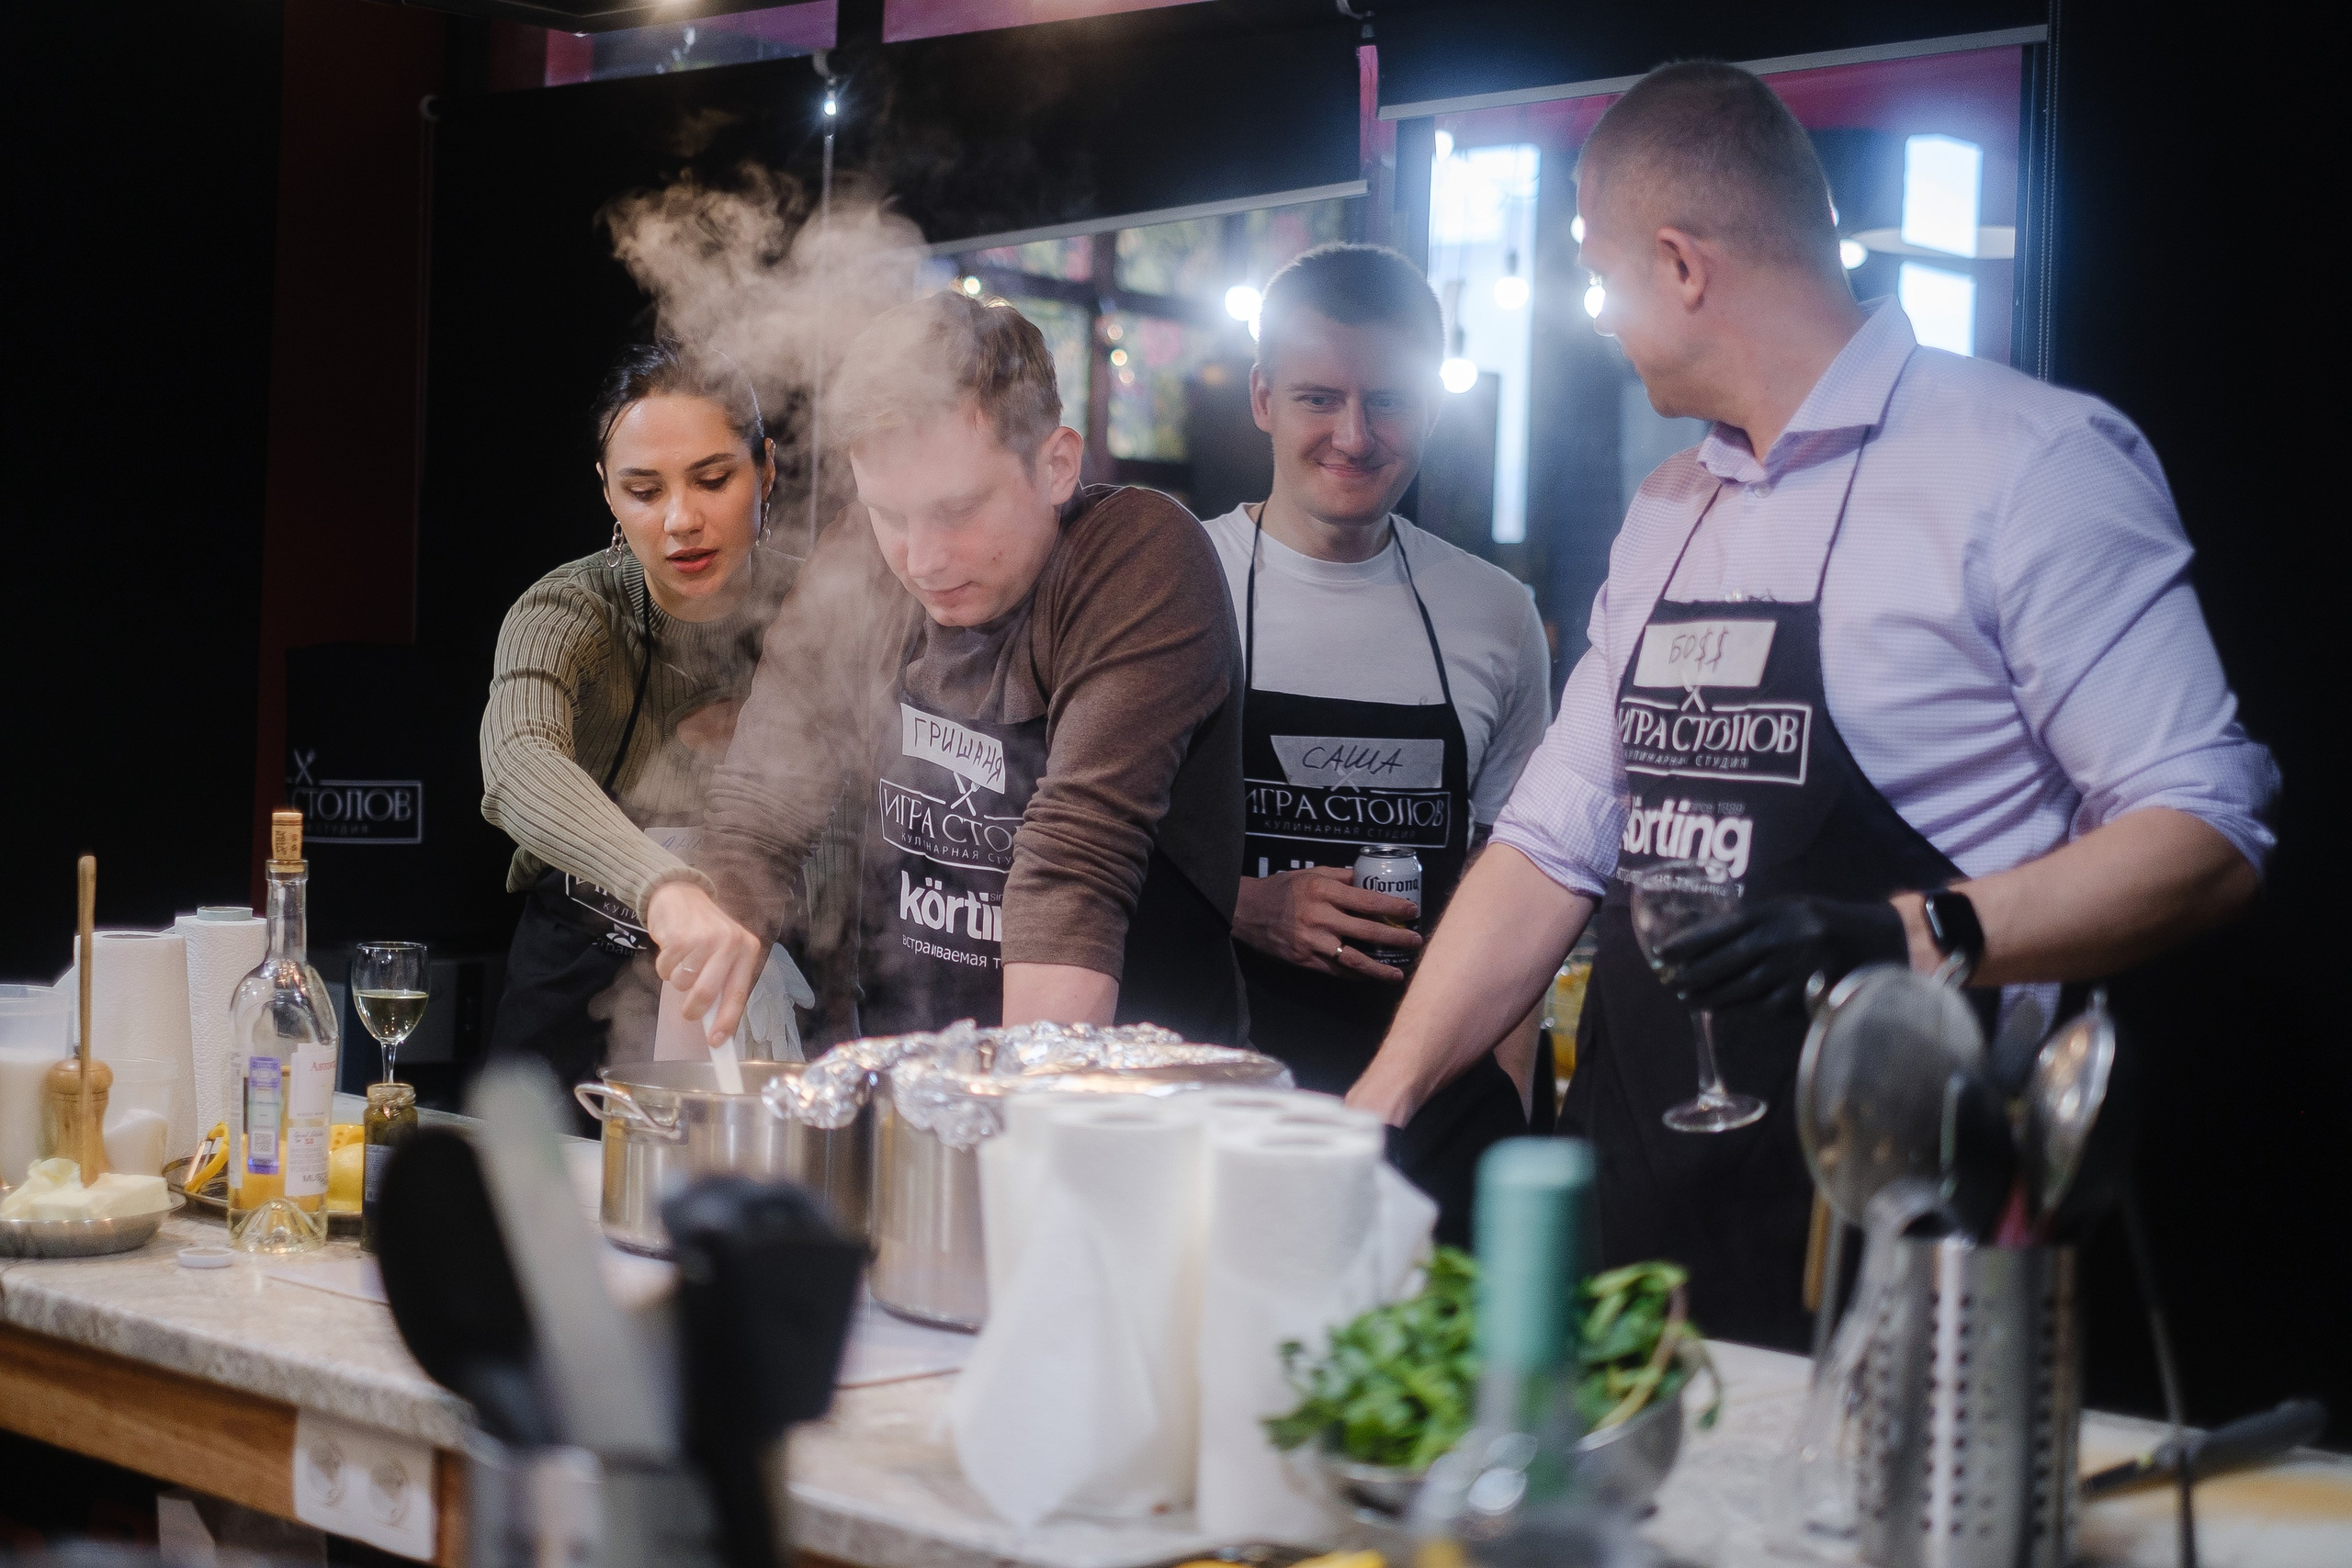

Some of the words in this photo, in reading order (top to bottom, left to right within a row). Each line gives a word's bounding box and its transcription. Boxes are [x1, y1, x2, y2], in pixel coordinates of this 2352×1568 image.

[1617, 708, 1667, 750] ИГРА
[1672, 714, 1800, 753] СТОЛОВ
[914, 717, 1002, 784] ГРИШАНЯ
[1302, 745, 1403, 774] САША
[884, 788, 935, 840] ИГРА
[942, 814, 1019, 853] СТО
[1325, 795, 1444, 827] СТОЛОВ
[1264, 820, 1360, 836] КУЛИНАРНАЯ
[1619, 795, 1754, 879] örting
[988, 852, 1012, 865] СТУ
[1363, 875, 1419, 892] Corona
[603, 901, 639, 919] КУЛИ
